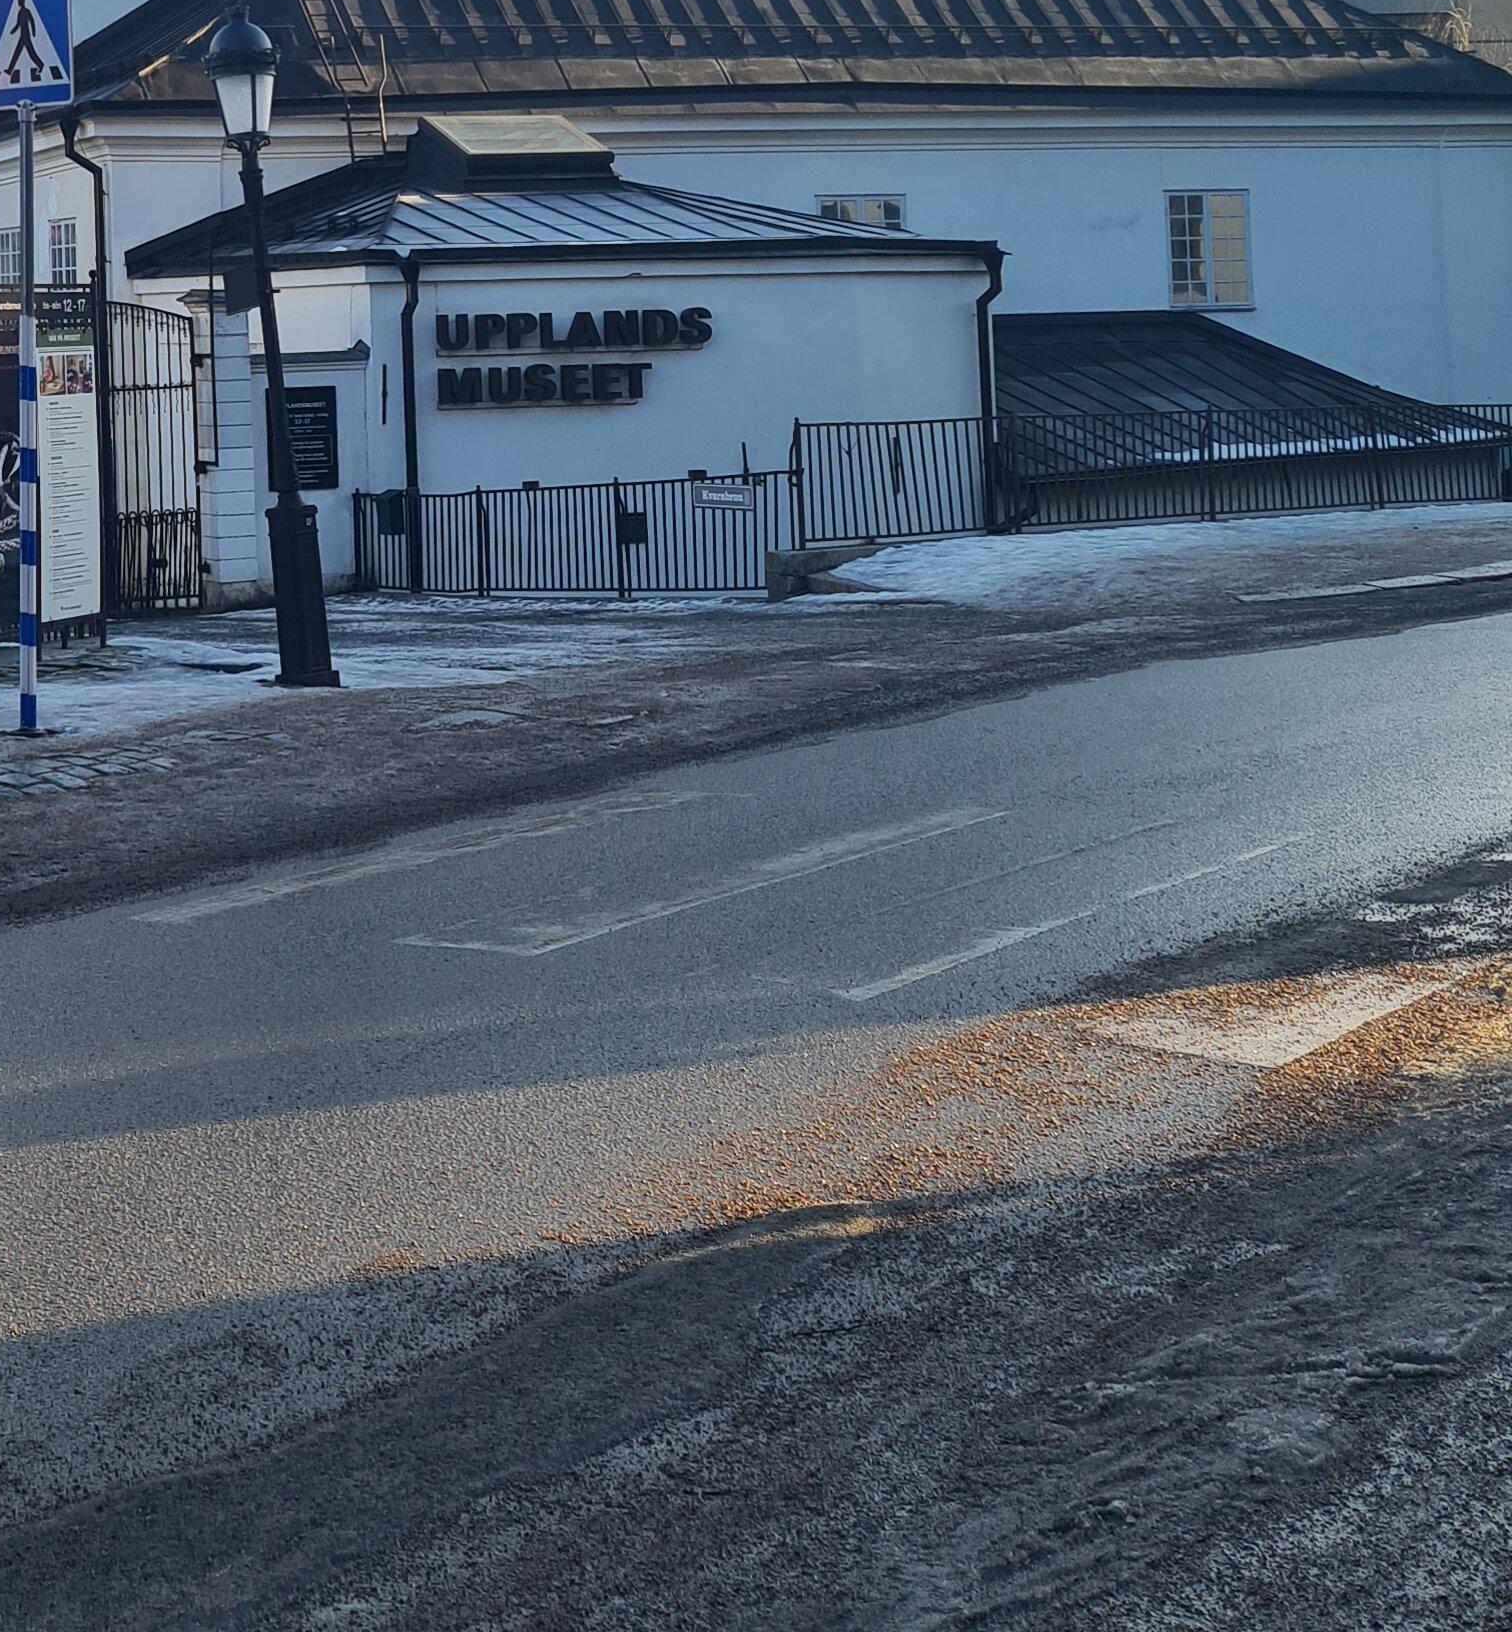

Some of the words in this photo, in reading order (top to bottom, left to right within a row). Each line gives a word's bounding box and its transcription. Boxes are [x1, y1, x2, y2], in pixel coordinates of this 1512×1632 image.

[63, 299, 85, 312] 12-17
[436, 307, 713, 350] UPPLANDS
[438, 363, 652, 404] MUSEET
